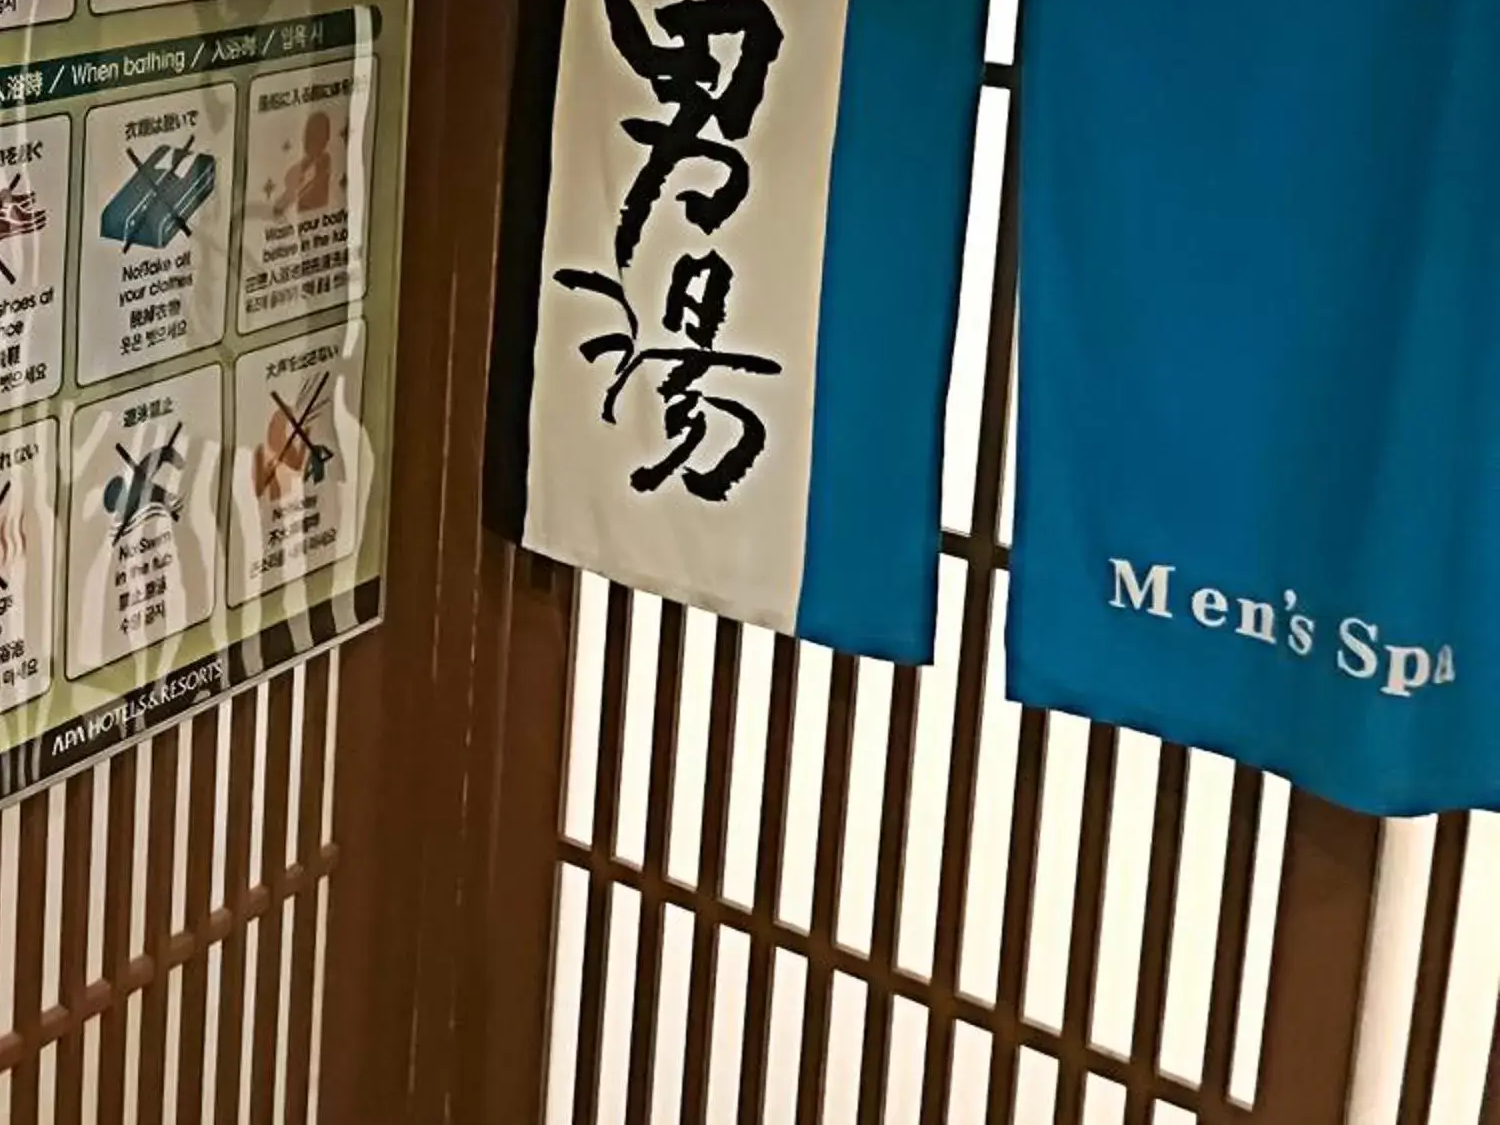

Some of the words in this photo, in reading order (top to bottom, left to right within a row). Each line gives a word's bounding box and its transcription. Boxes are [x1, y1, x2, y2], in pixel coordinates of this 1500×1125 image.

[71, 62, 119, 88] When
[122, 48, 186, 82] bathing
[39, 286, 54, 306] at
[119, 285, 147, 307] your
[1108, 557, 1316, 656] Men's
[52, 724, 85, 756] APA
[161, 658, 224, 703] RESORTS
